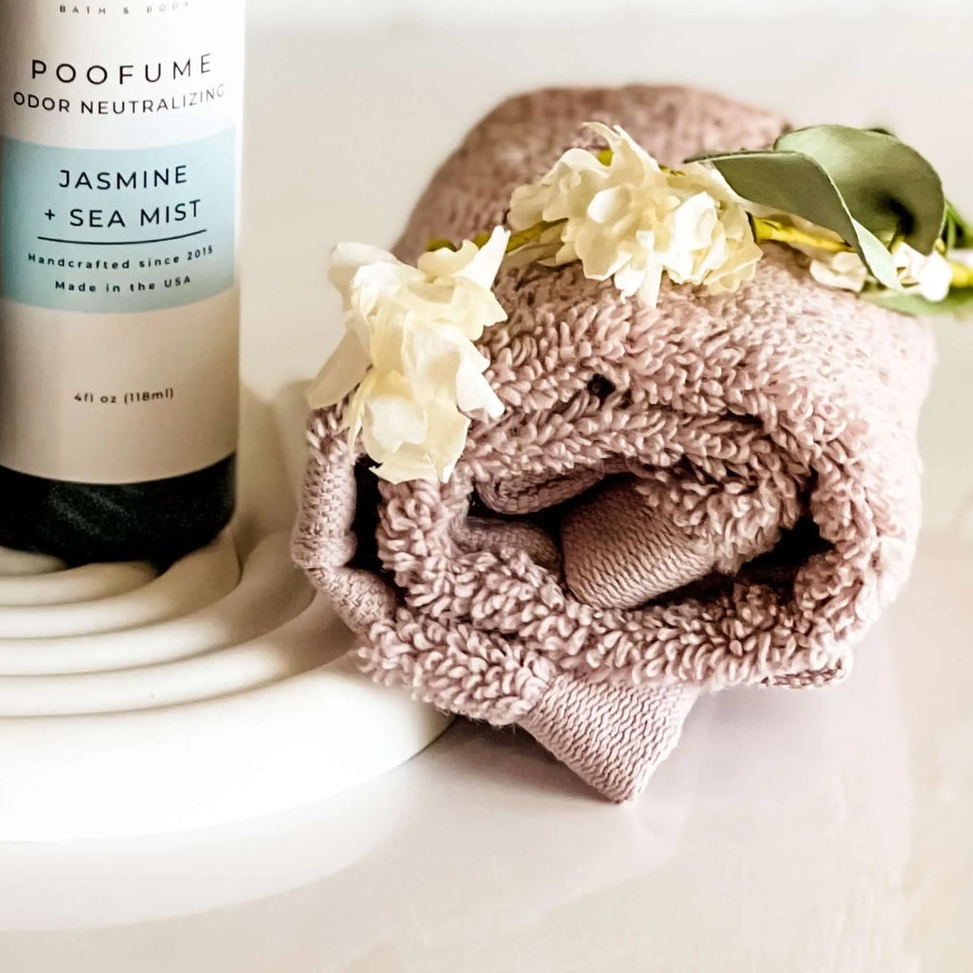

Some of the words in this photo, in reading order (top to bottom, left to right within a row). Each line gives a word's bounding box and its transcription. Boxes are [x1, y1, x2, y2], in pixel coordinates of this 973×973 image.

[59, 4, 106, 15] BATH
[31, 53, 212, 85] POOFUME
[13, 91, 71, 113] ODOR
[81, 84, 226, 115] NEUTRALIZING
[59, 165, 188, 190] JASMINE
[44, 208, 56, 221] +
[69, 208, 126, 228] SEA
[140, 199, 201, 226] MIST
[28, 252, 130, 270] Handcrafted
[139, 254, 180, 268] since
[187, 245, 214, 261] 2015
[55, 280, 97, 293] Made
[106, 283, 121, 293] in
[130, 282, 156, 292] the
[164, 275, 192, 288] USA
[73, 392, 94, 403] 4fl
[100, 395, 117, 404] oz
[123, 387, 174, 405] (118ml)
